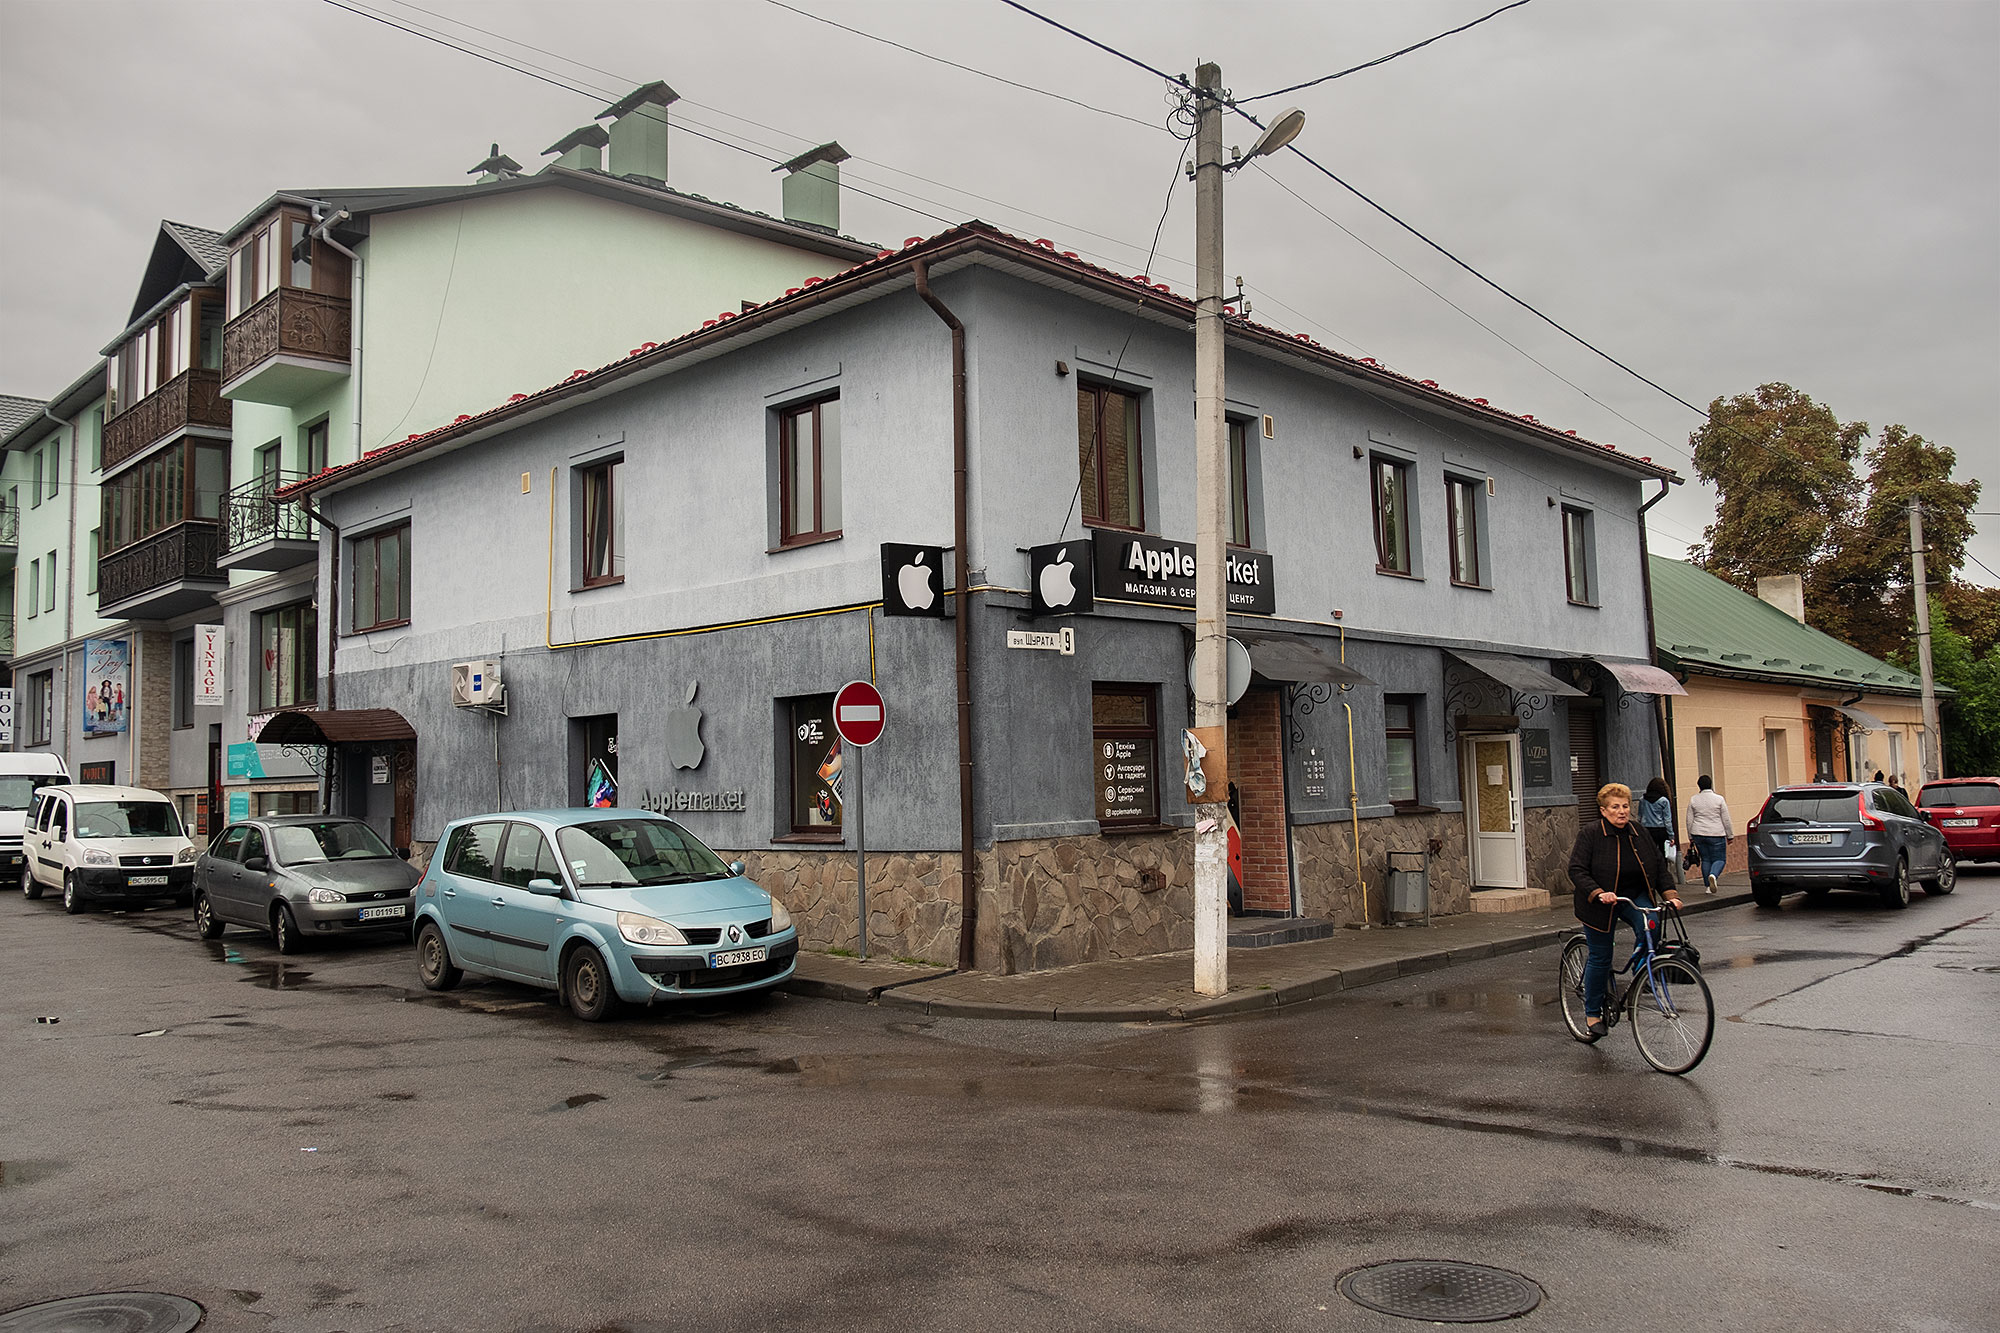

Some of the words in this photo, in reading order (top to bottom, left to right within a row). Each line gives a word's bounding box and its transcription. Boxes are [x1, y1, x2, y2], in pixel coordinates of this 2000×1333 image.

[1129, 541, 1260, 585] Applerket
[1125, 583, 1167, 597] МАГАЗИН
[1170, 587, 1177, 597] &
[1230, 593, 1255, 604] ЦЕНТР
[1065, 631, 1071, 651] 9
[91, 656, 125, 674] Joy
[204, 634, 216, 695] VINTAGE
[0, 691, 11, 741] HOME
[1115, 742, 1136, 750] Техніка
[1116, 750, 1132, 759] Apple
[641, 787, 746, 814] Applemarket
[716, 954, 729, 966] BC
[731, 951, 750, 964] 2938
